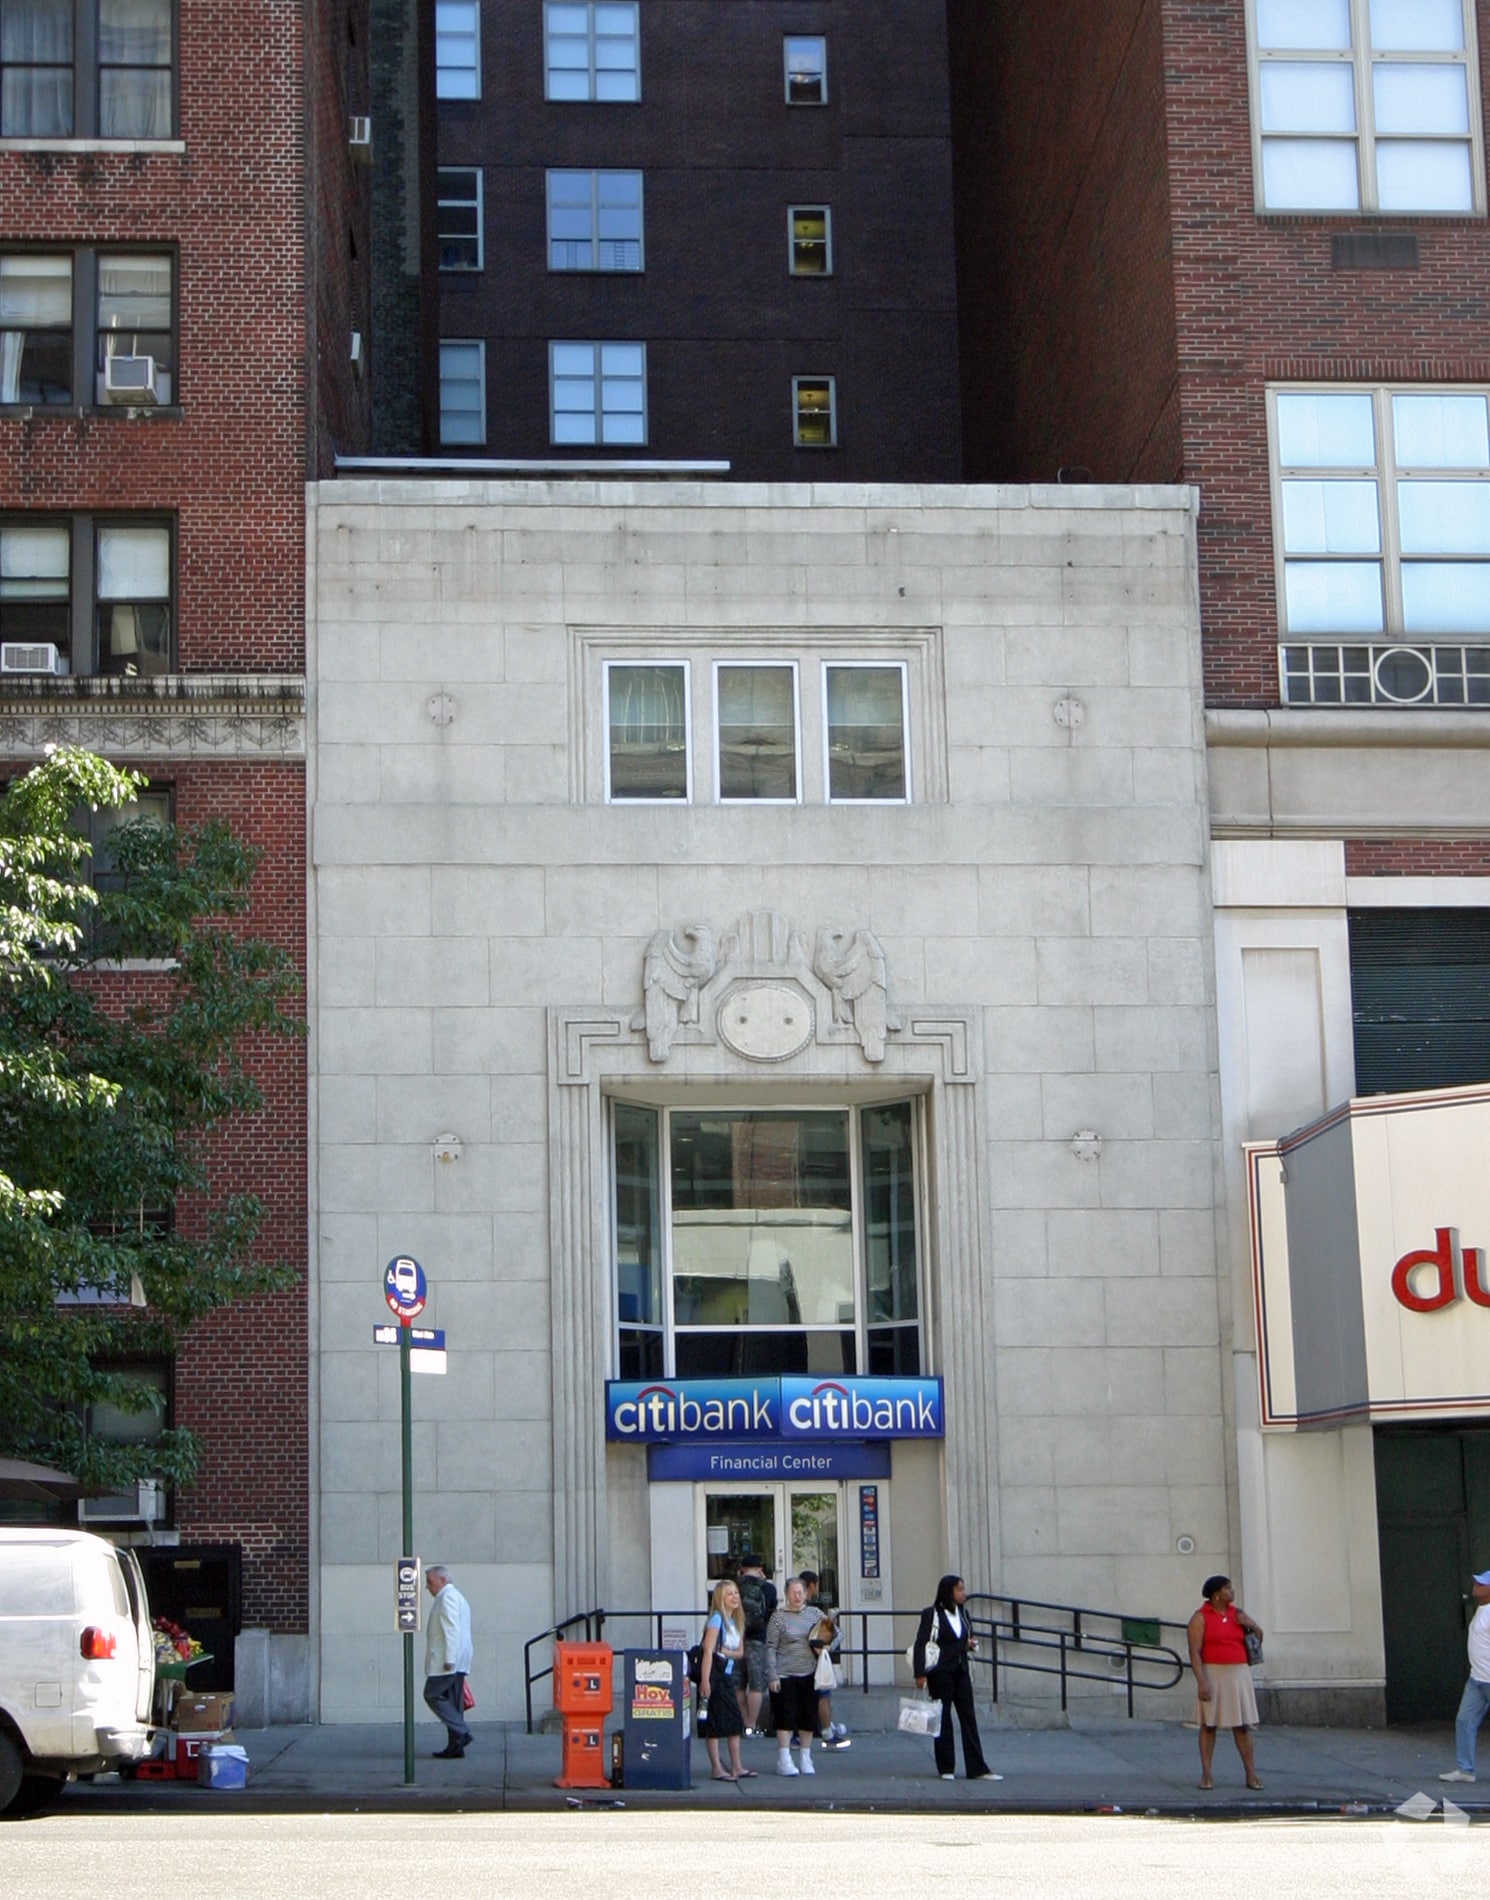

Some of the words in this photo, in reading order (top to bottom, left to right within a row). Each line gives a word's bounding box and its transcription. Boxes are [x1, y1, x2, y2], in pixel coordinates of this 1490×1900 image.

[614, 1389, 773, 1433] citibank
[789, 1389, 936, 1430] citibank
[710, 1455, 778, 1470] Financial
[782, 1455, 833, 1470] Center
[635, 1685, 669, 1702] Hoy
